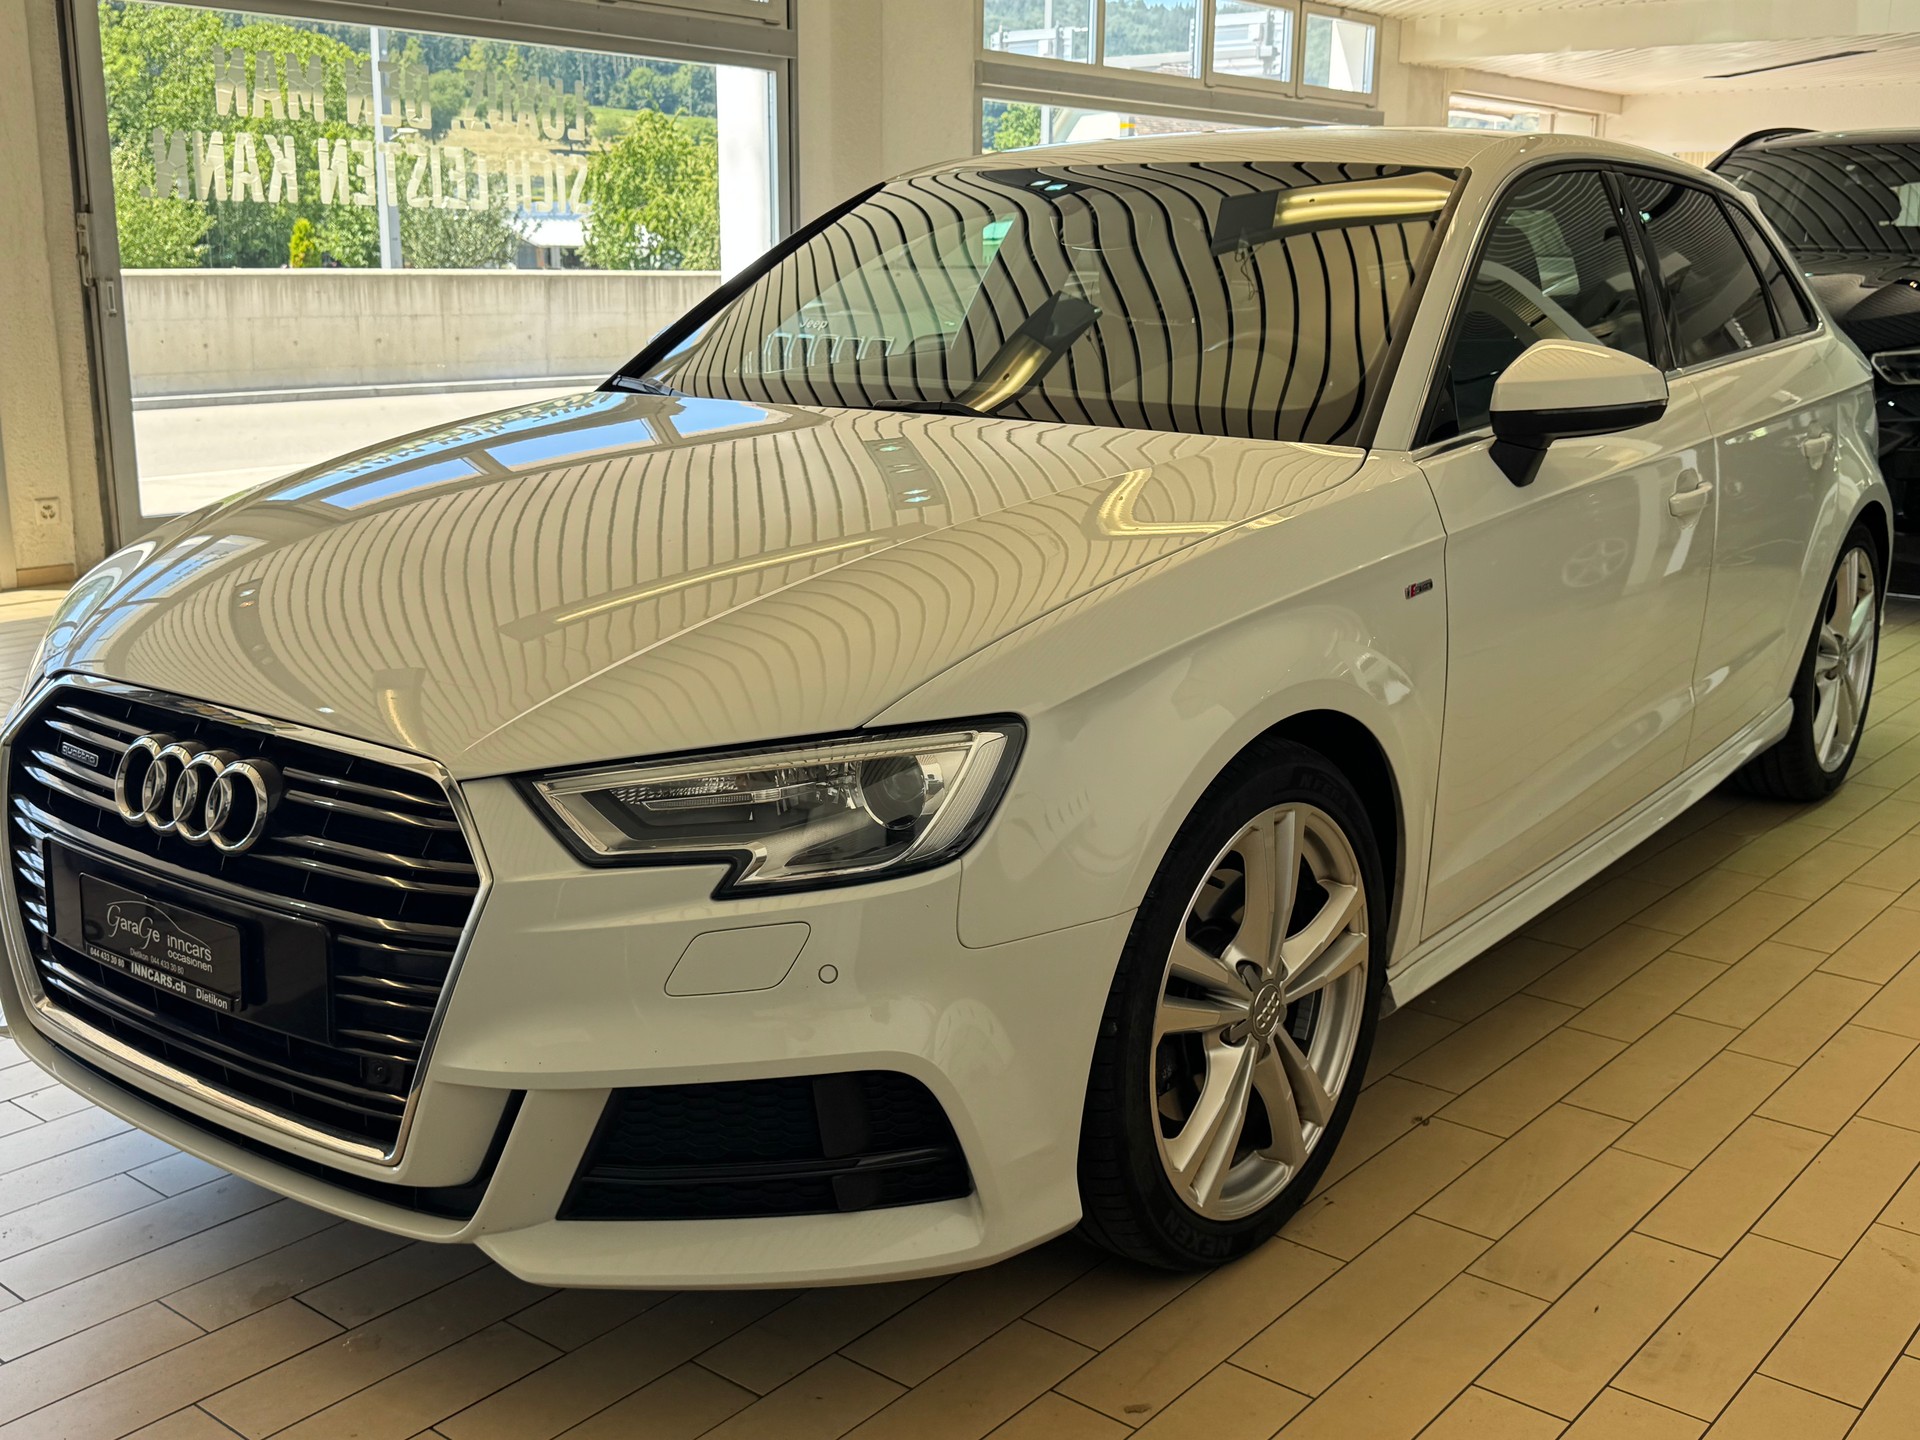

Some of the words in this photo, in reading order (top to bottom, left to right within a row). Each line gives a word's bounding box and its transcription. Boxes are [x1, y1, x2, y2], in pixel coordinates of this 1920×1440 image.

[799, 318, 829, 331] Jeep
[62, 744, 95, 763] quattro
[106, 904, 160, 950] GaraGe
[167, 935, 212, 962] inncars
[130, 948, 149, 960] Dietikon
[150, 957, 160, 966] 044
[160, 960, 170, 970] 433
[170, 963, 177, 972] 30
[177, 966, 184, 974] 80
[167, 950, 213, 973] occasionen
[90, 948, 100, 957] 044
[101, 951, 110, 961] 433
[110, 956, 117, 964] 30
[118, 959, 124, 967] 80
[130, 962, 187, 994] INNCARS.ch
[196, 988, 228, 1010] Dietikon
[1163, 1208, 1233, 1257] NEXEN
